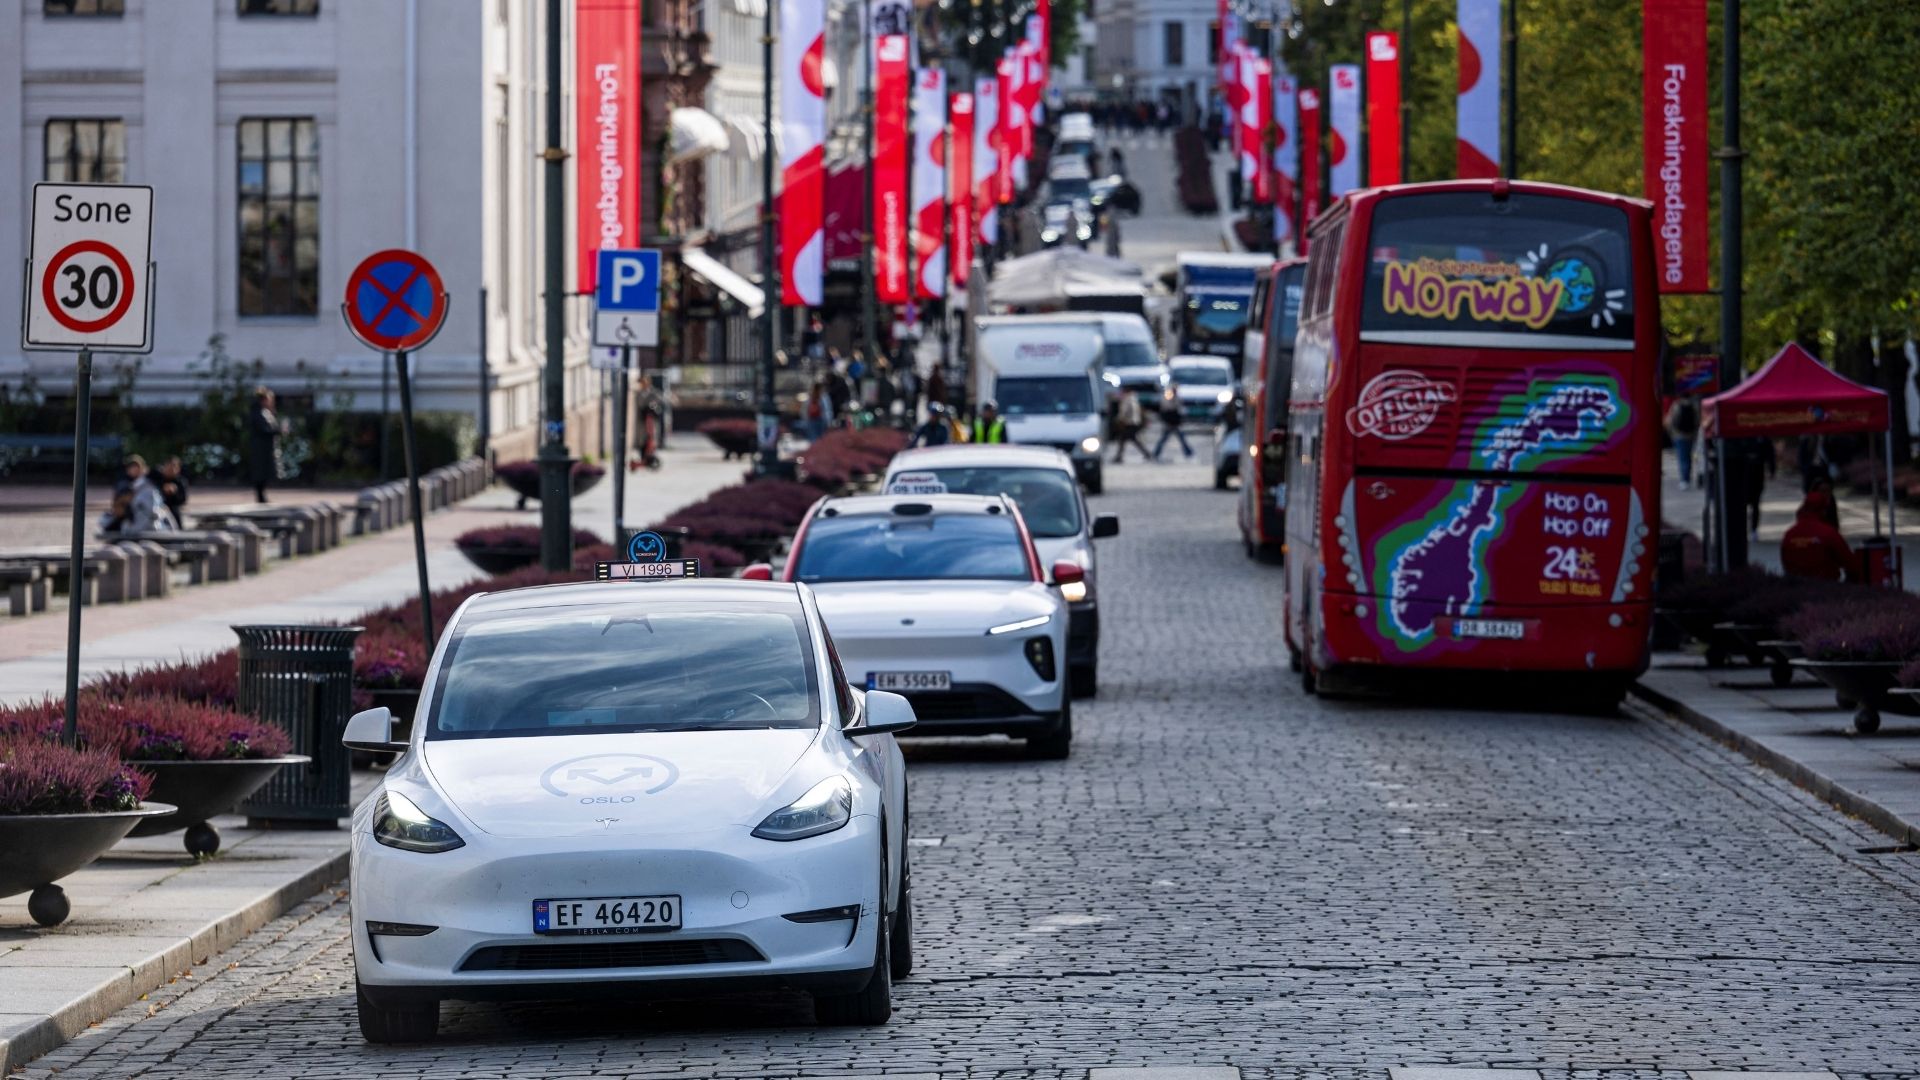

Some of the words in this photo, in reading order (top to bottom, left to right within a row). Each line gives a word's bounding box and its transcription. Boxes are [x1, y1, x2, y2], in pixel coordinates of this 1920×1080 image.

[1660, 63, 1686, 284] Forskningsdagene
[53, 194, 132, 224] Sone
[60, 264, 118, 310] 30
[611, 257, 645, 304] P
[1386, 262, 1562, 326] Norway
[1357, 384, 1457, 429] OFFICIAL
[1544, 492, 1580, 514] Hop
[1583, 492, 1609, 514] On
[1543, 515, 1579, 537] Hop
[1582, 516, 1611, 537] Off
[622, 565, 635, 576] VI
[640, 564, 672, 576] 1996
[1542, 545, 1577, 579] 24
[878, 674, 897, 688] EH
[903, 673, 948, 688] 55049
[580, 795, 636, 805] OSLO
[556, 903, 583, 926] EF
[594, 900, 673, 925] 46420
